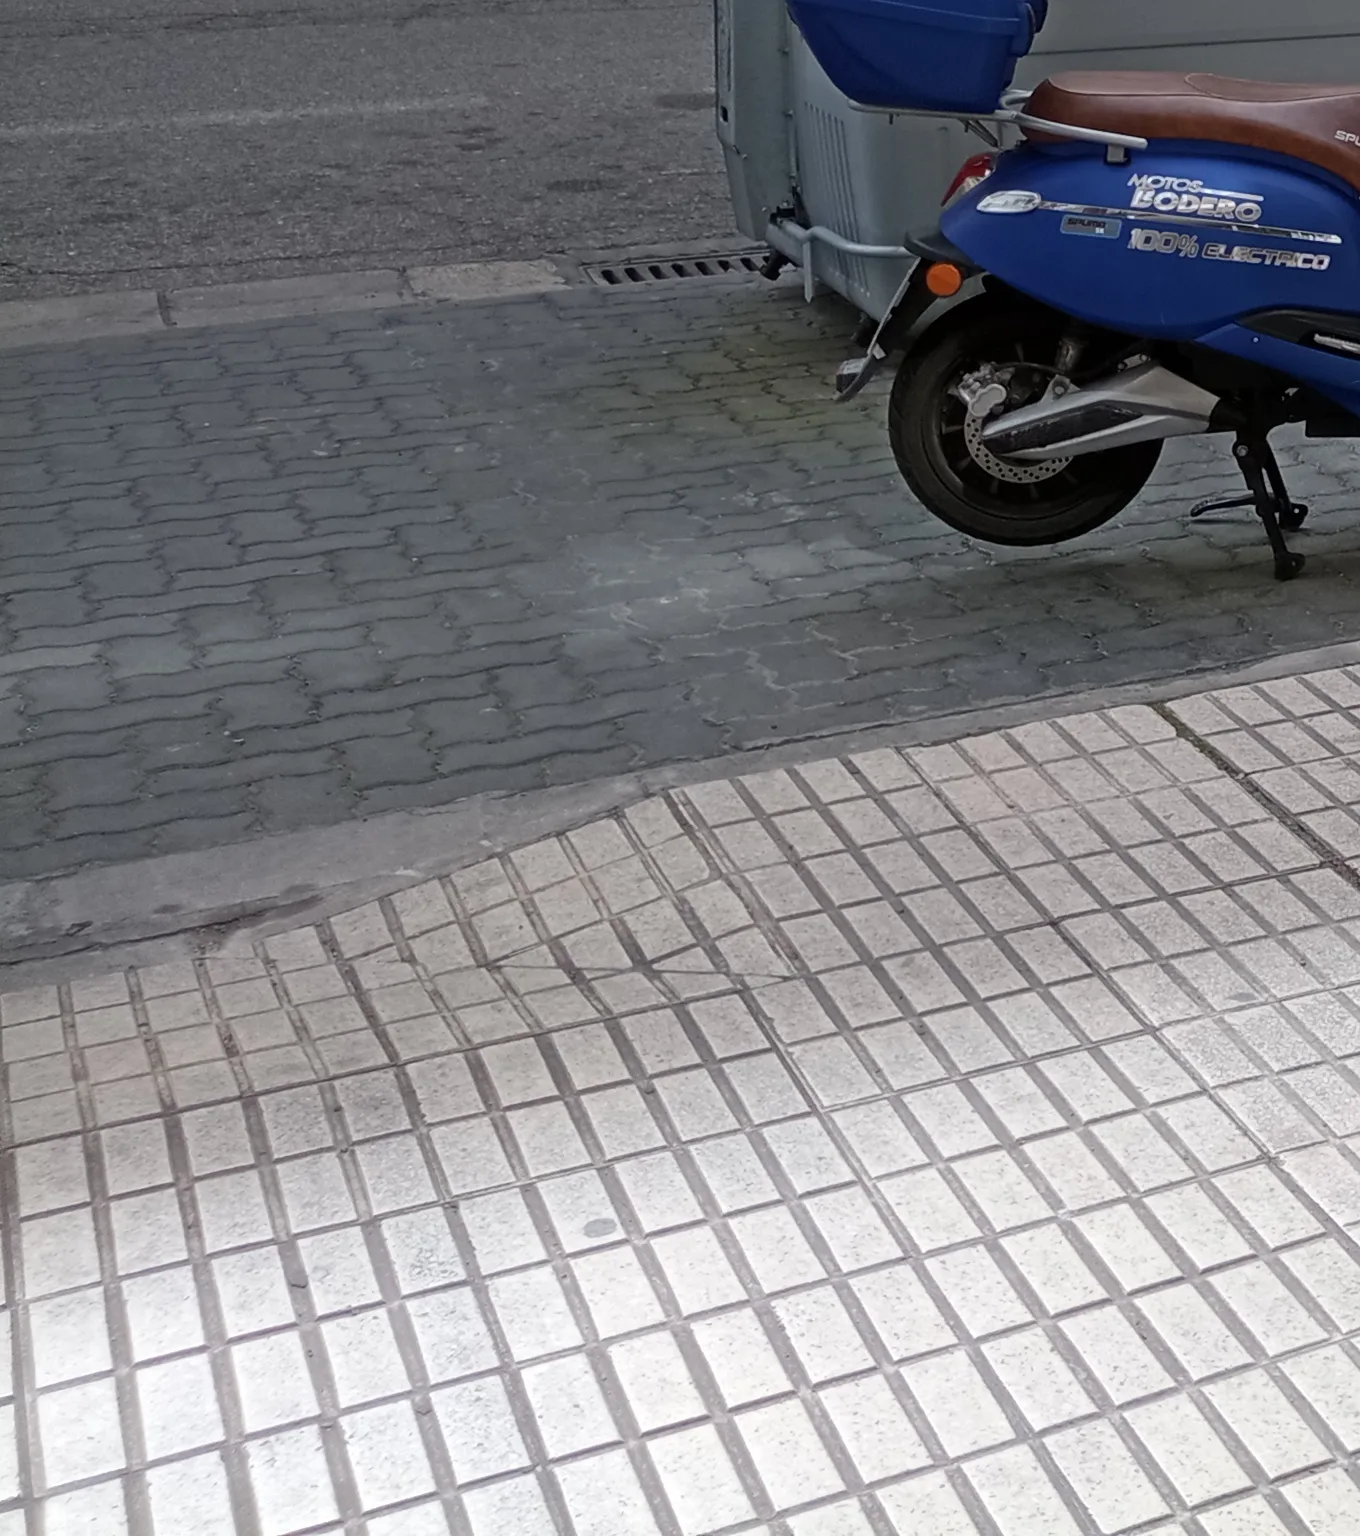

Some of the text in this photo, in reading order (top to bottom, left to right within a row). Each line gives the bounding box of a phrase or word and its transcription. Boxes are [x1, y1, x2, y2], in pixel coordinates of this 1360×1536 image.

[1127, 172, 1204, 194] MOTOS
[1129, 188, 1263, 222] BODERO
[1127, 228, 1331, 271] 100% ELECTRICO
